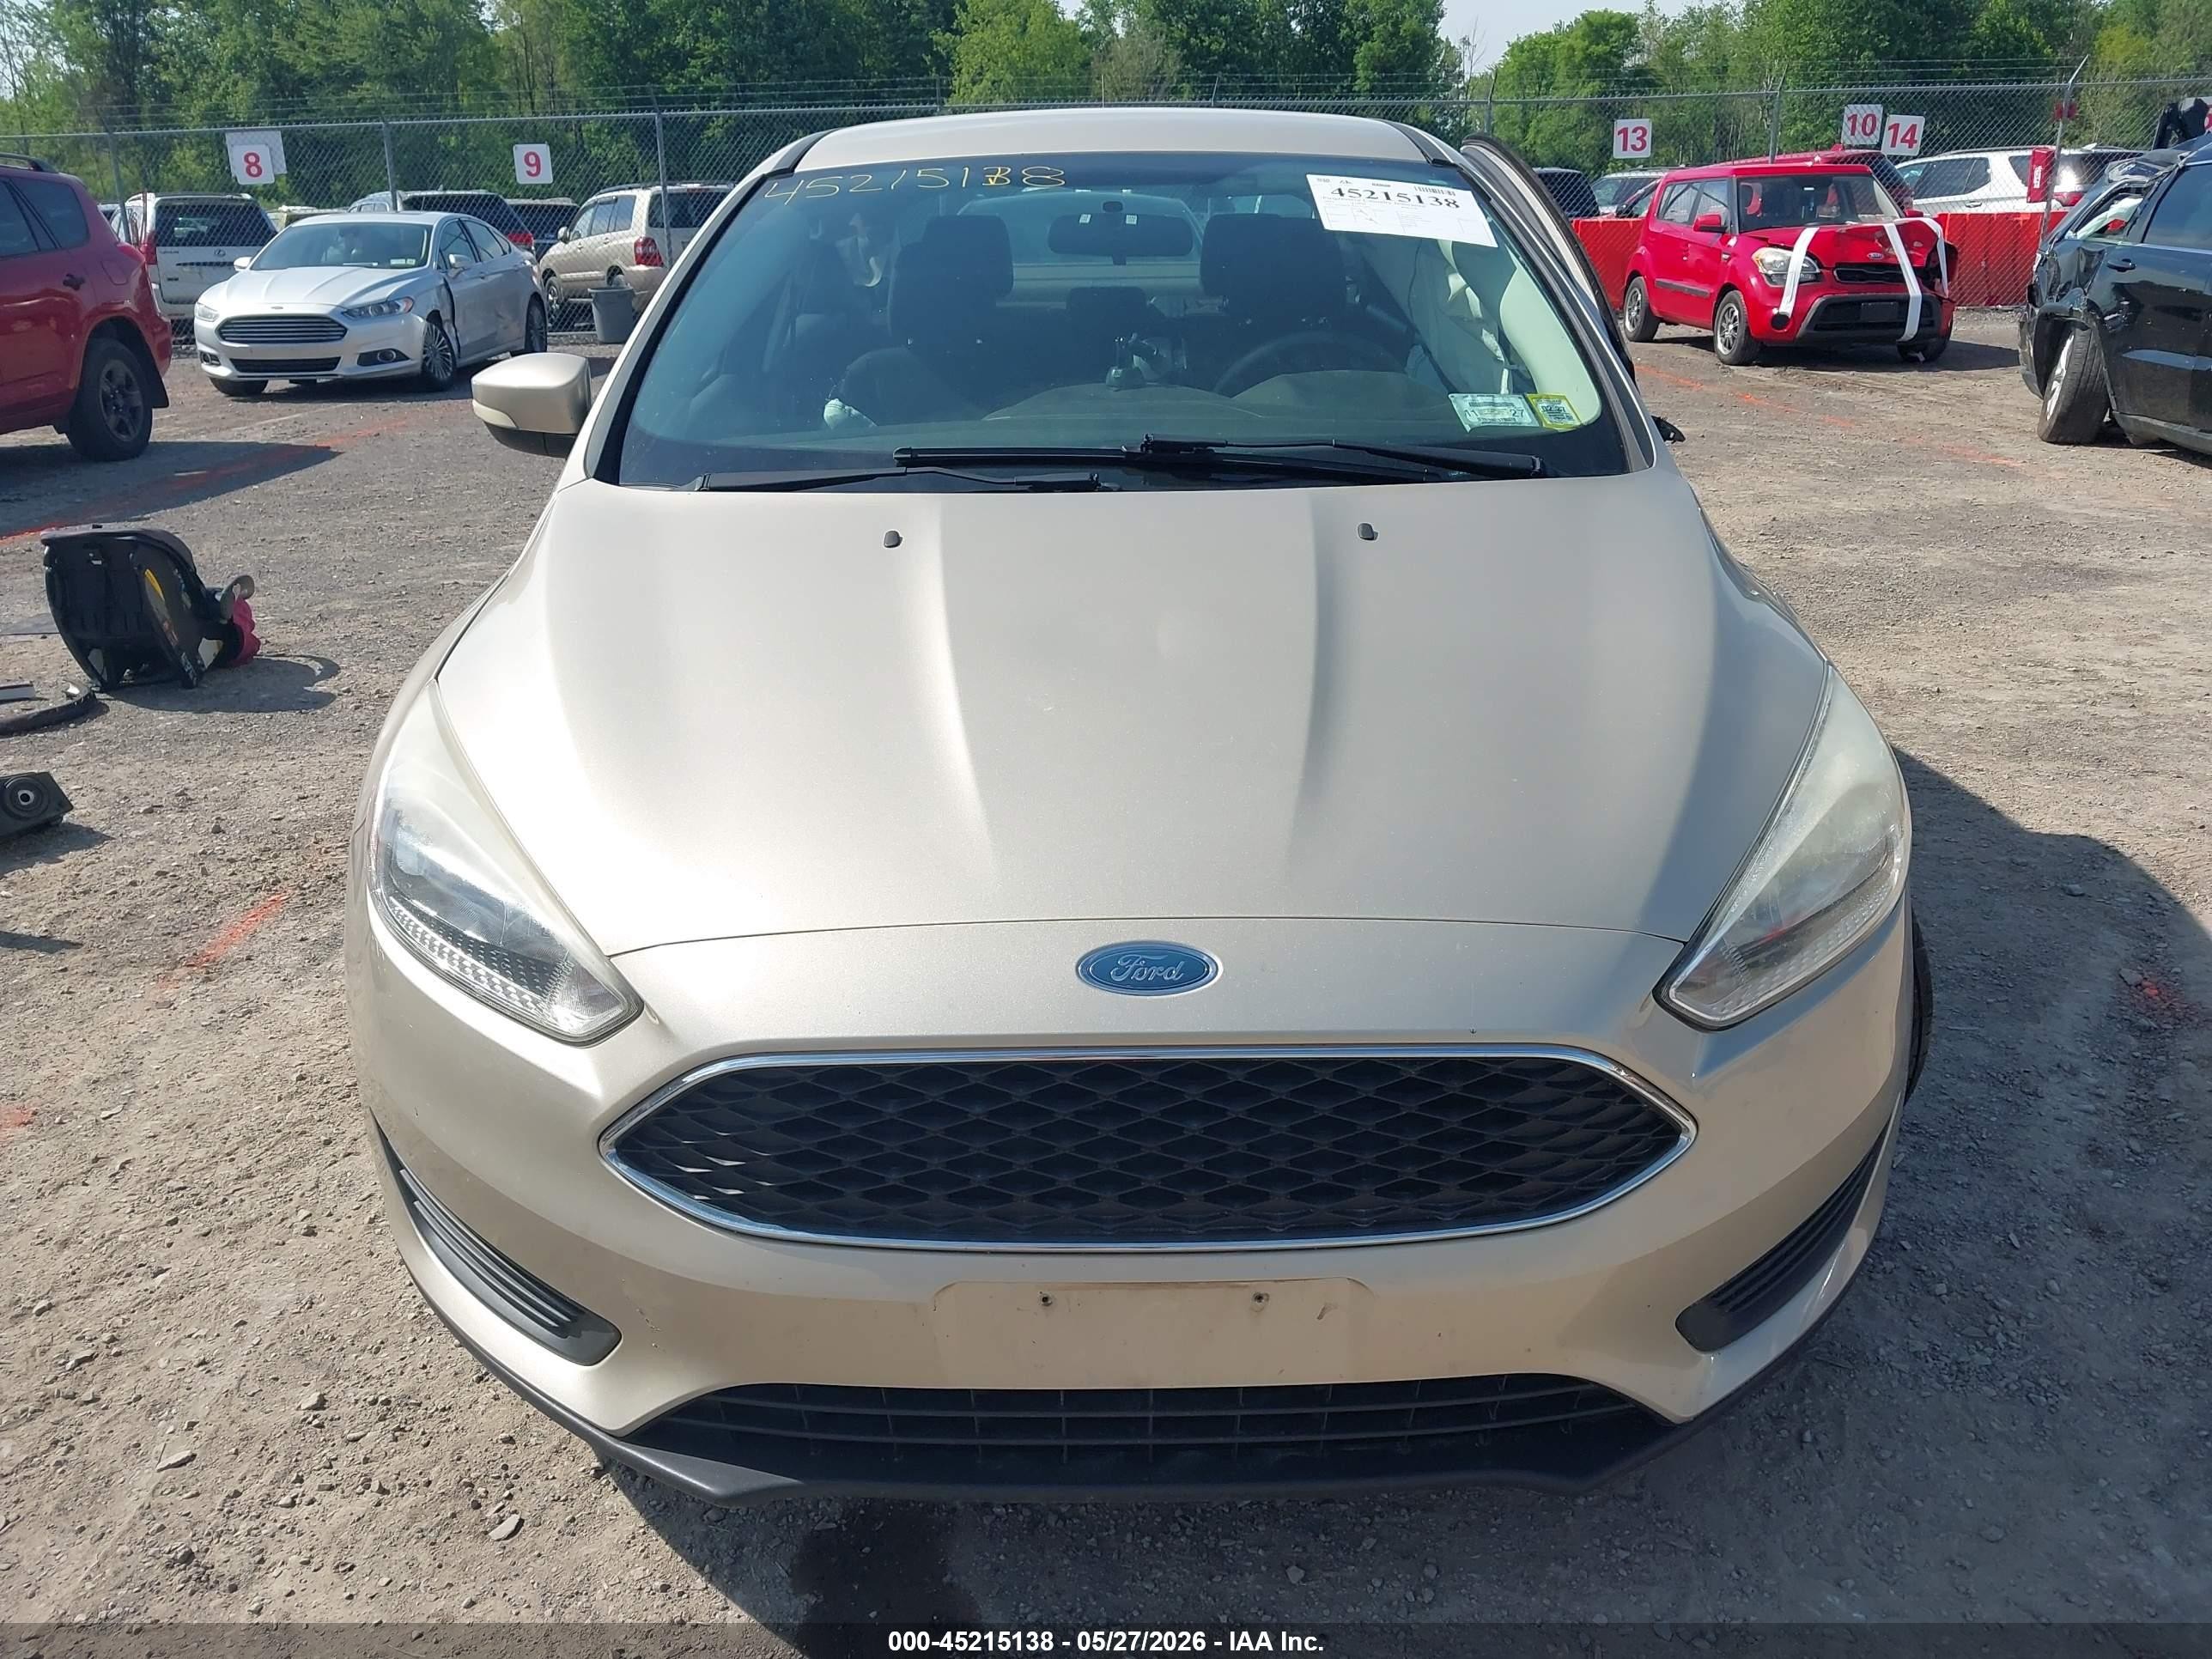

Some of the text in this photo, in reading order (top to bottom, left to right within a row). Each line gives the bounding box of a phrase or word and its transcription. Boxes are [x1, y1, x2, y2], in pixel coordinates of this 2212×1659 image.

[1847, 113, 1876, 137] 10
[1888, 123, 1917, 149] 14
[1617, 125, 1648, 152] 13
[244, 152, 263, 178] 8
[524, 151, 541, 177] 9
[1331, 186, 1461, 209] 45215138
[1110, 954, 1185, 981] Ford
